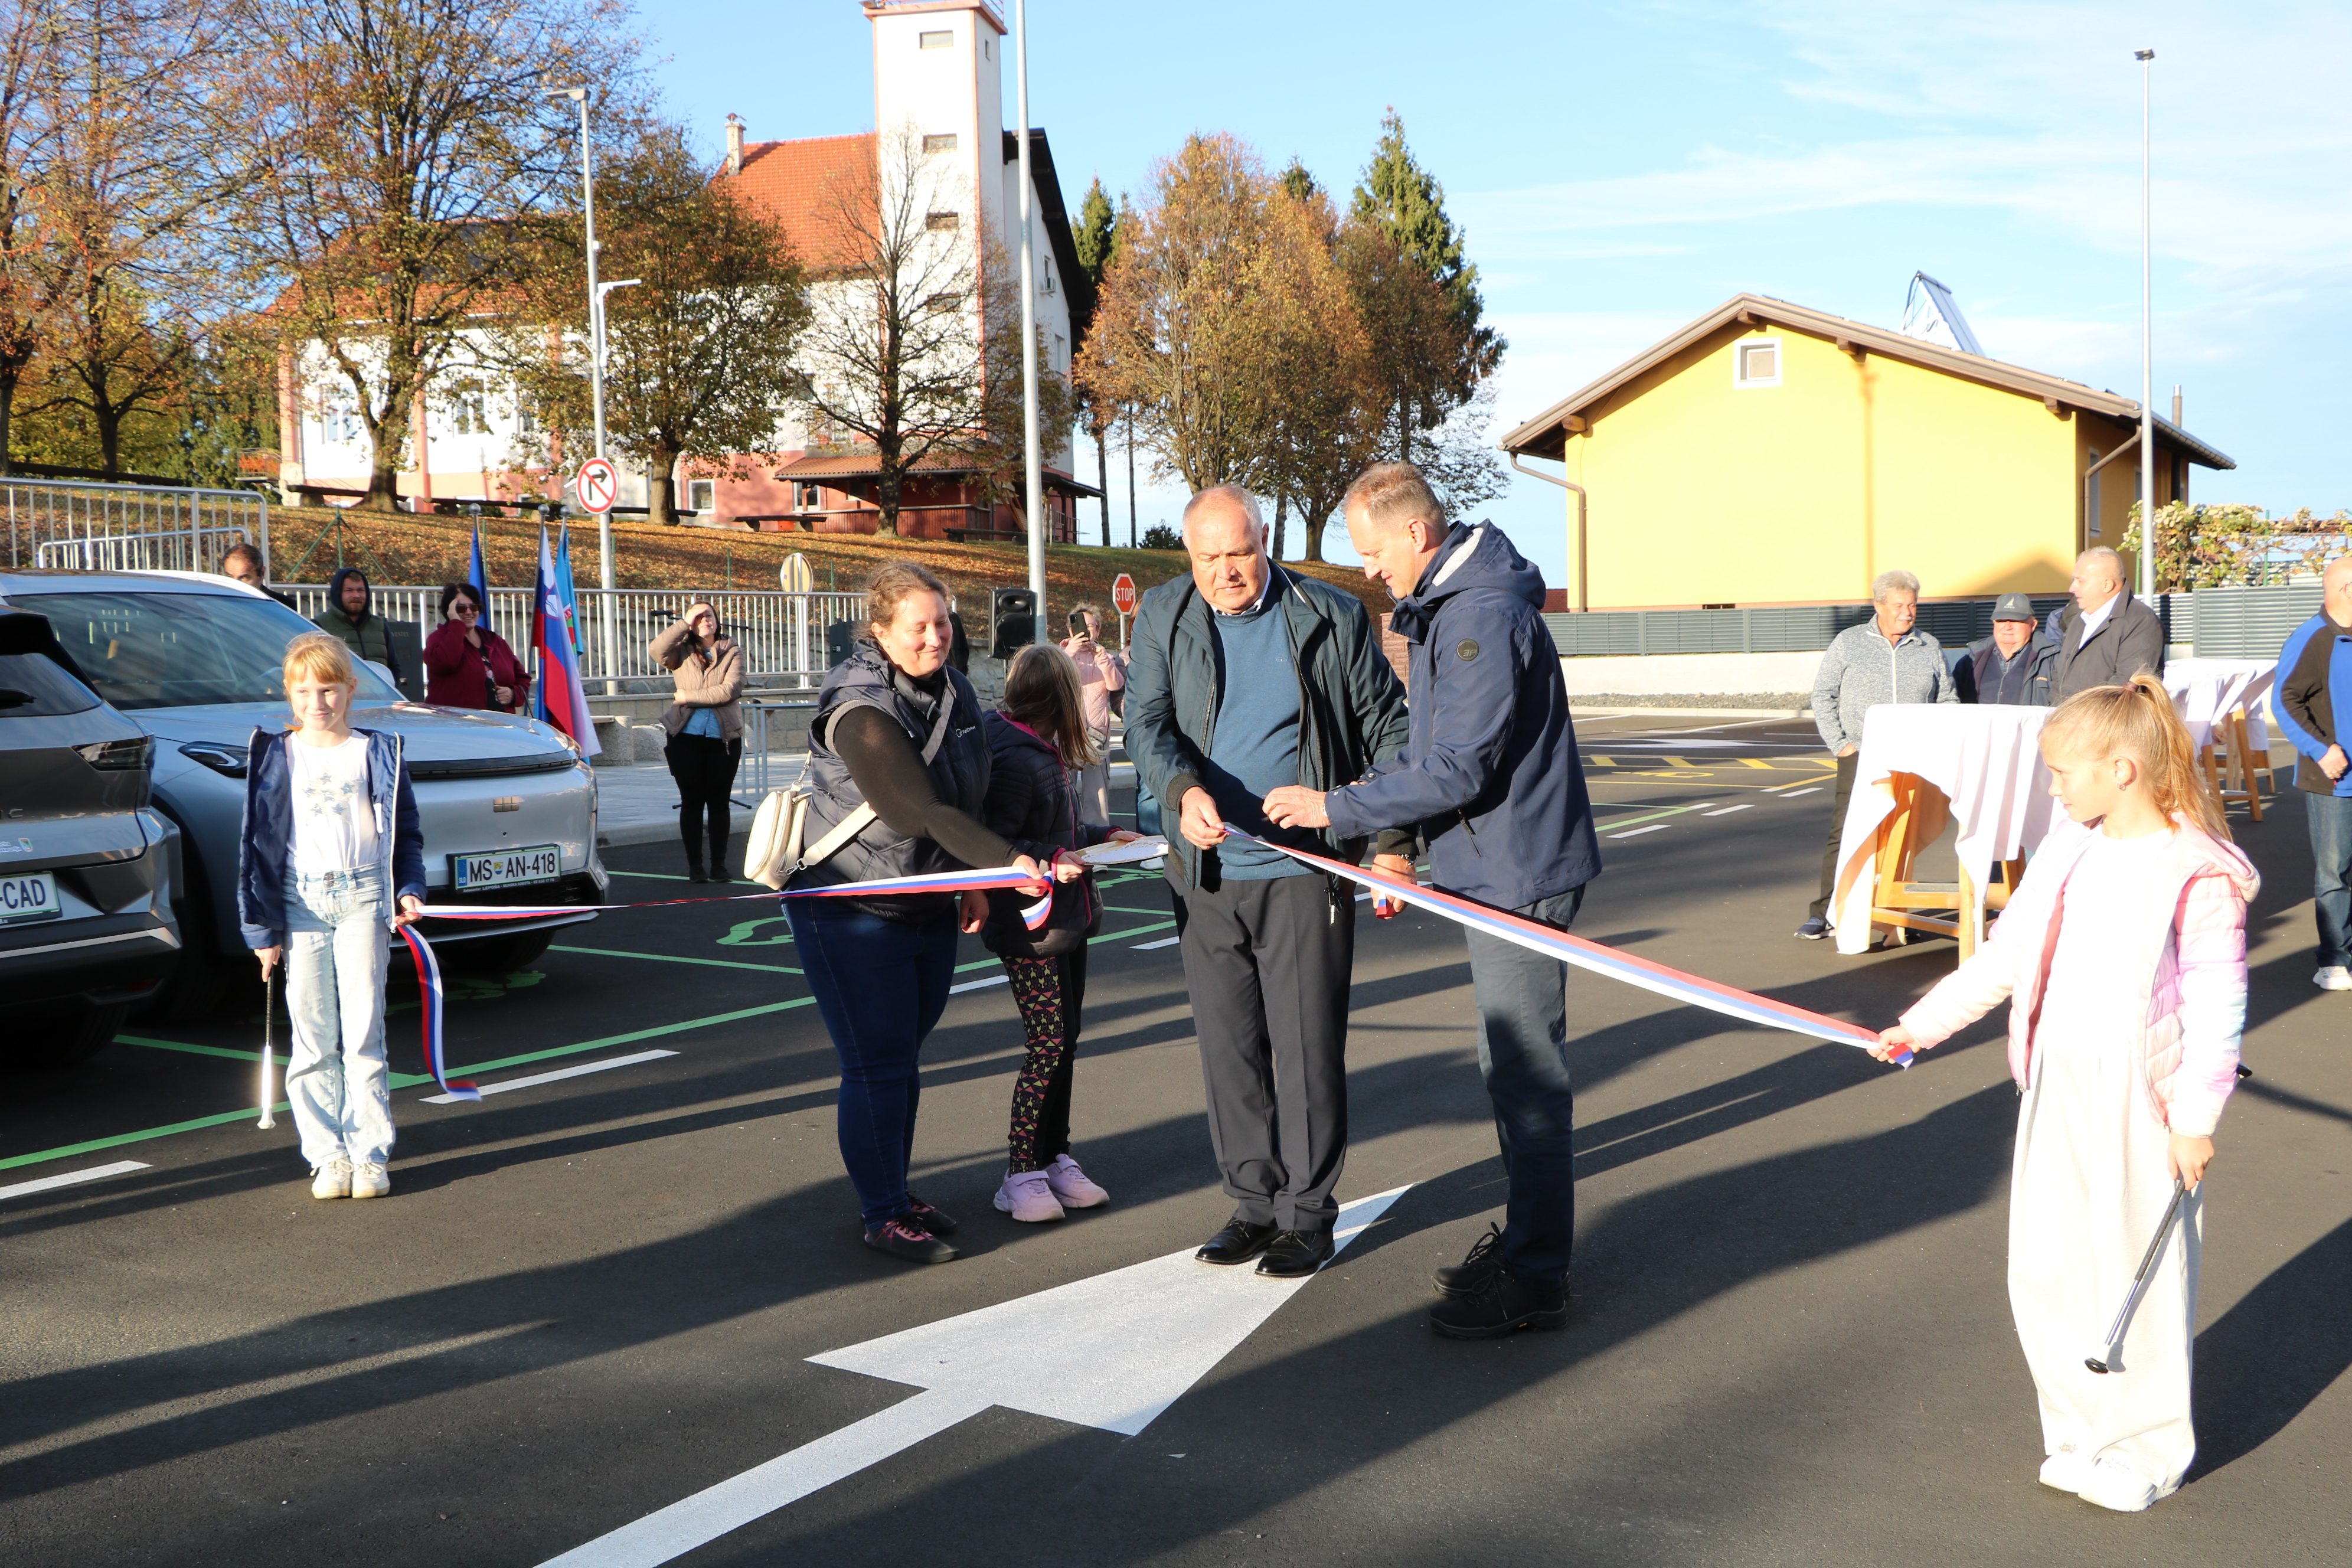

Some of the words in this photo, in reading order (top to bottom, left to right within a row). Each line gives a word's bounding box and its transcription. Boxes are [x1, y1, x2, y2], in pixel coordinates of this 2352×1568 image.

[1116, 587, 1133, 601] STOP
[470, 860, 492, 882] MS
[505, 852, 555, 878] AN-418
